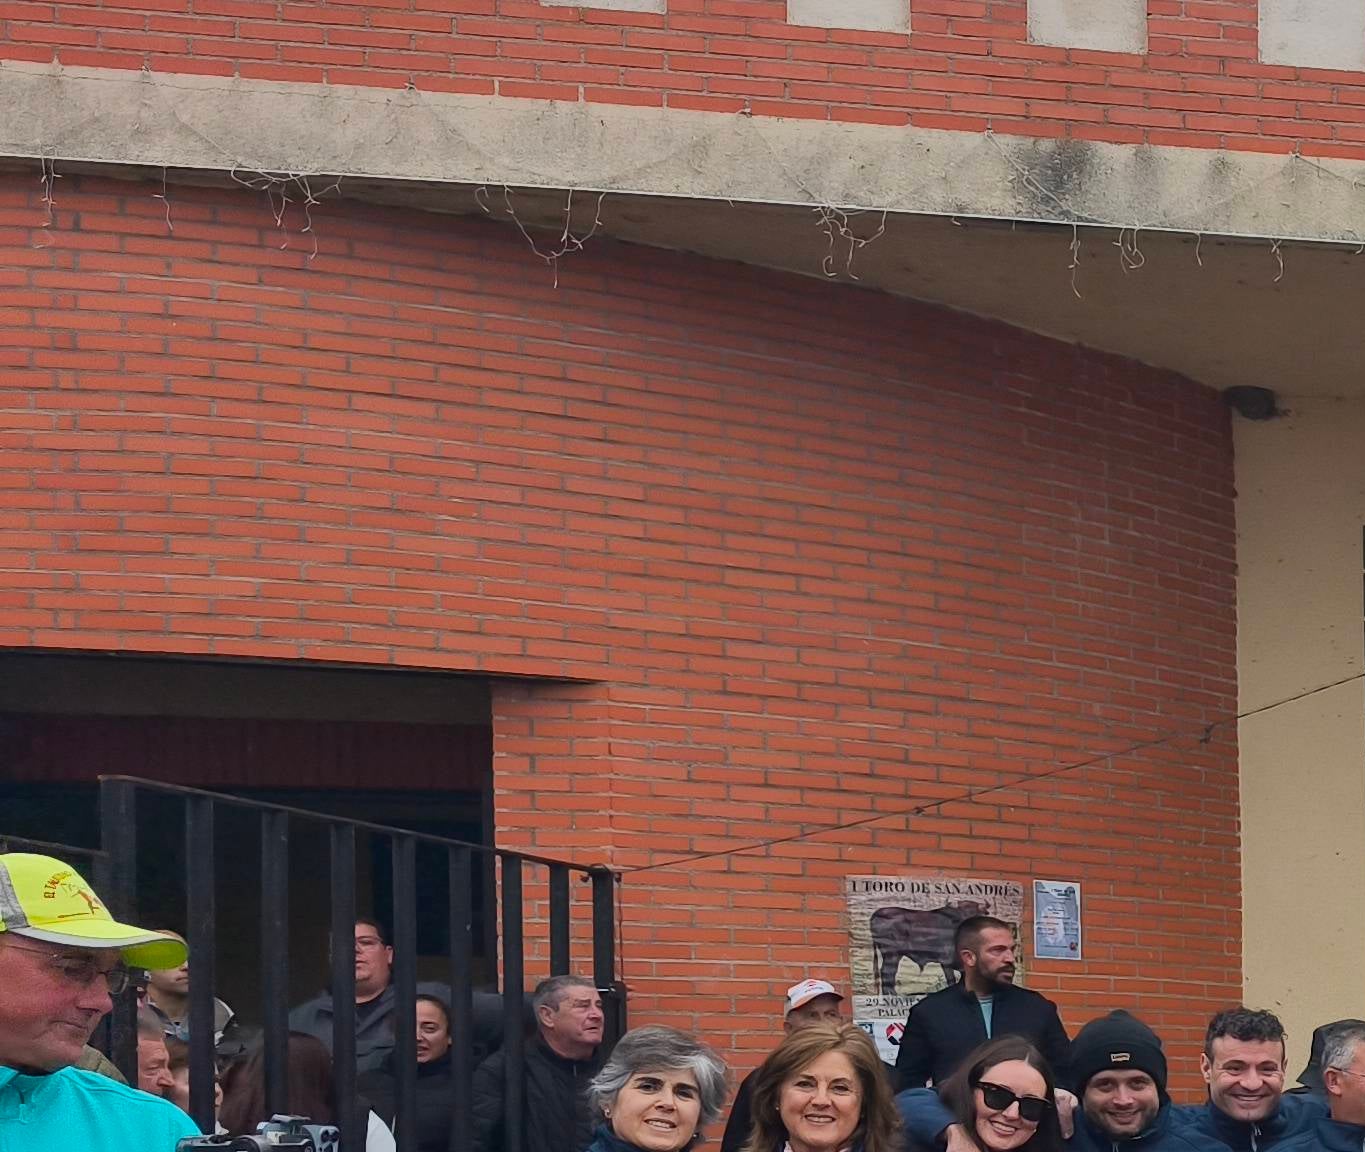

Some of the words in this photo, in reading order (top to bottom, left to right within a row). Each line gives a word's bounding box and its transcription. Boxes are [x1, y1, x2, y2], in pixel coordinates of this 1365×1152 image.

[862, 880, 906, 893] TORO
[911, 881, 931, 894] DE
[934, 882, 961, 895] SAN
[967, 882, 1020, 896] ANDRÉS
[865, 997, 879, 1007] 29
